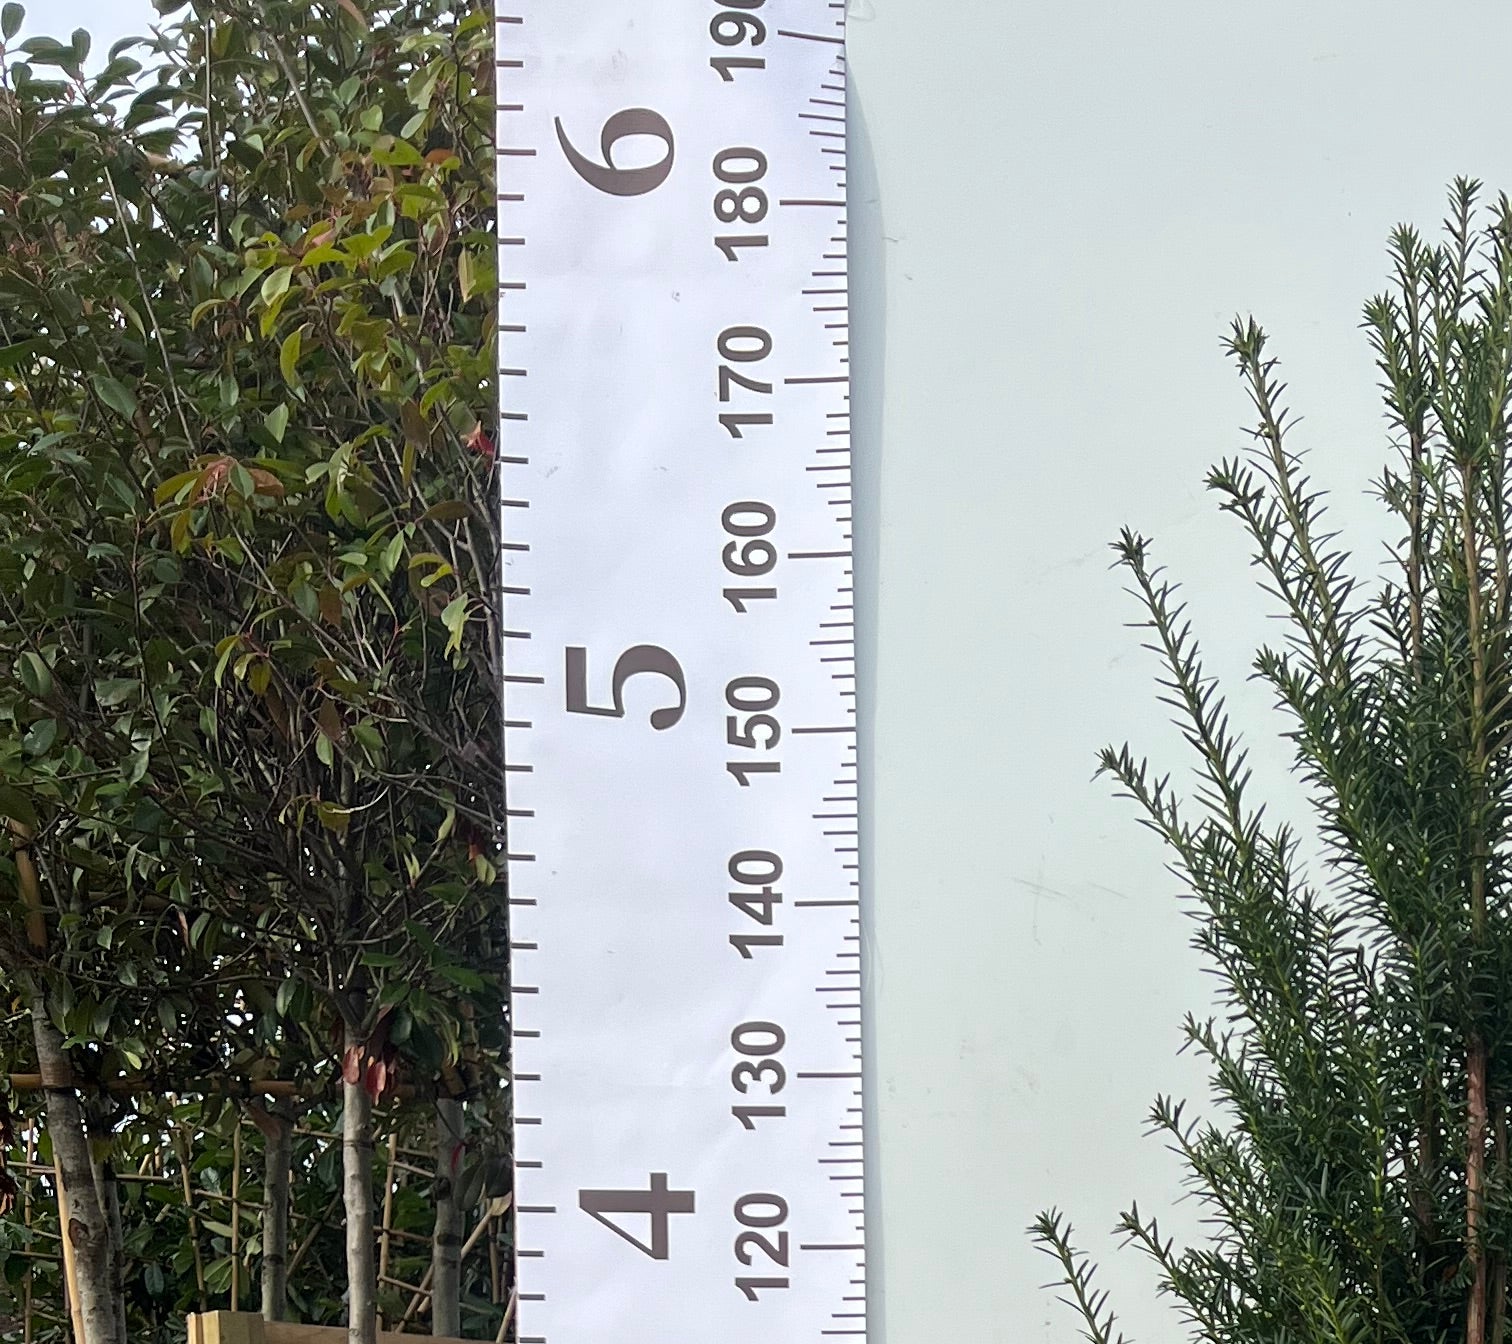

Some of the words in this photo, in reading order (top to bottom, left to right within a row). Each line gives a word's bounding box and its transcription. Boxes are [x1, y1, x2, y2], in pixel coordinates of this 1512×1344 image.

[709, 0, 766, 82] 19
[555, 109, 673, 196] 6
[713, 148, 768, 262] 180
[718, 327, 772, 439] 170
[722, 502, 777, 613] 160
[566, 645, 686, 731] 5
[726, 677, 781, 787] 150
[729, 851, 784, 959] 140
[731, 1022, 786, 1130] 130
[579, 1172, 695, 1260] 4
[734, 1194, 789, 1302] 120
